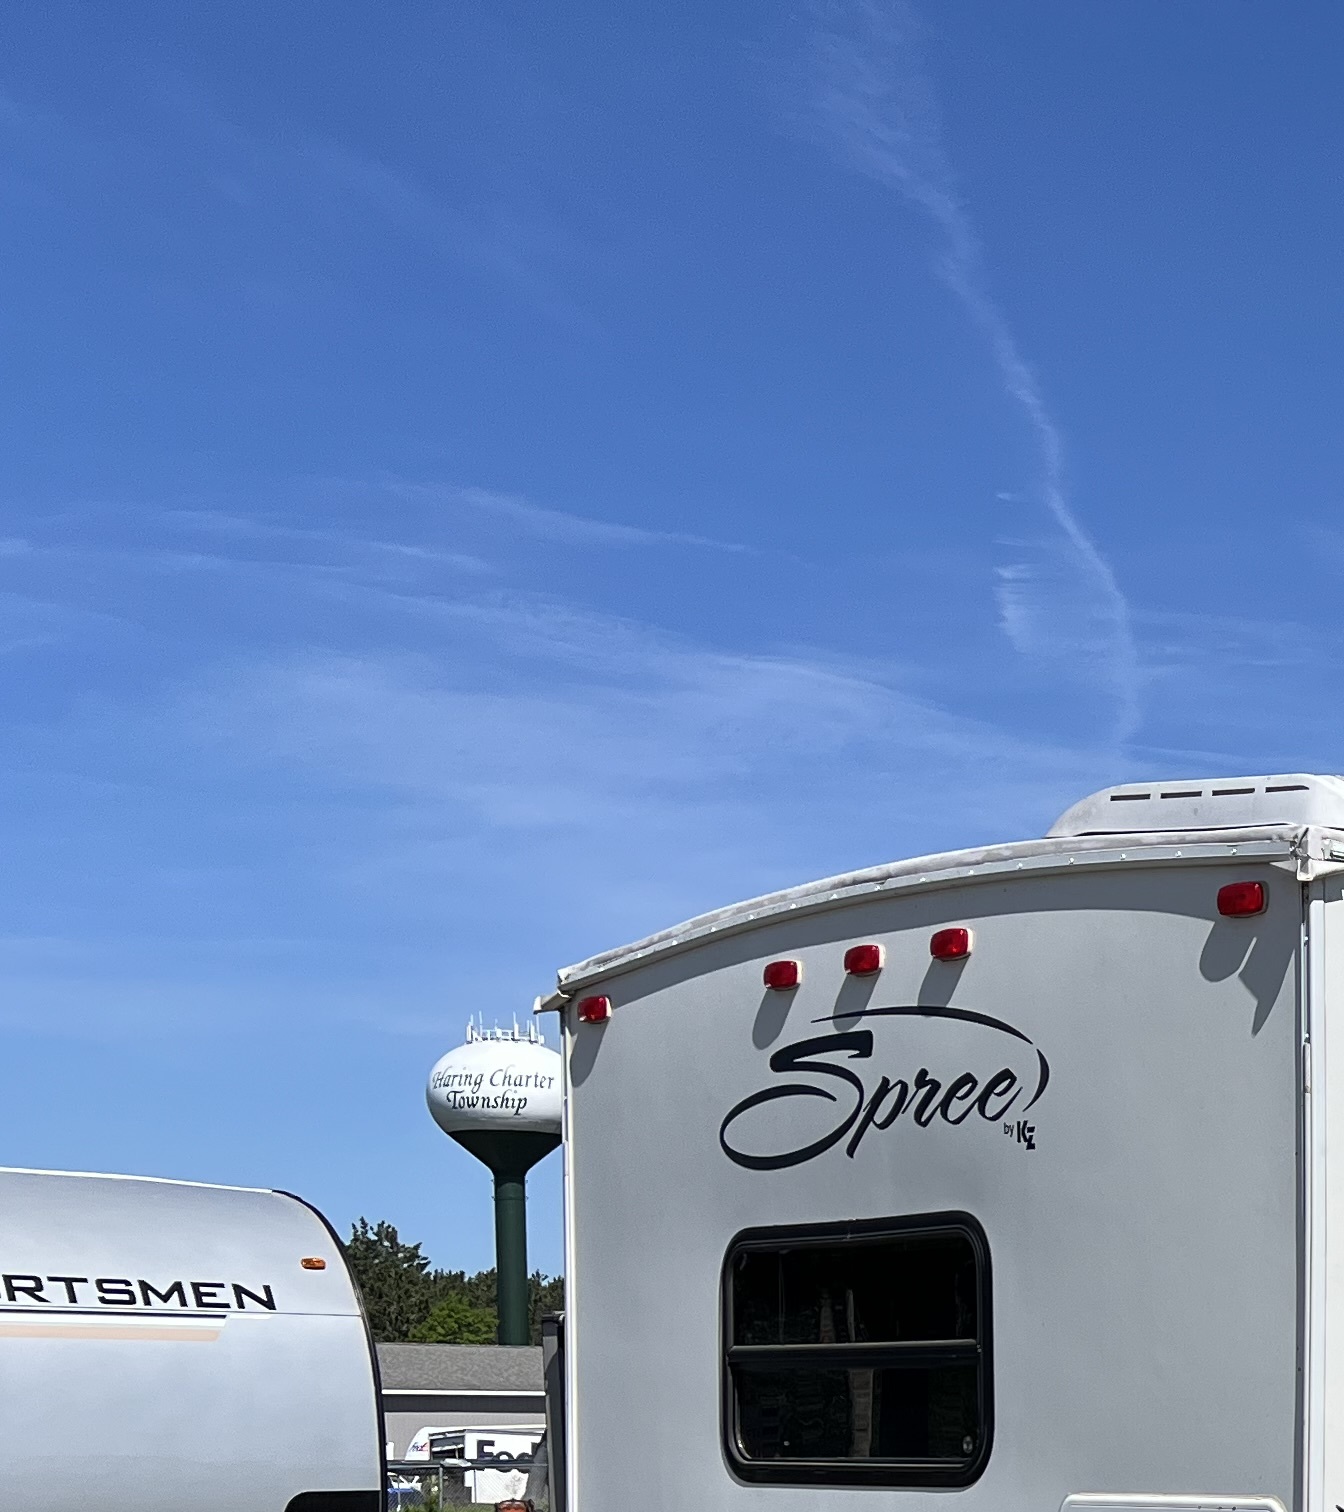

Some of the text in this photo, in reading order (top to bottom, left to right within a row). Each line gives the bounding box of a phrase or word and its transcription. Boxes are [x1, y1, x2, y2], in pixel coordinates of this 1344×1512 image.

[432, 1064, 555, 1094] Haring Charter
[446, 1089, 528, 1116] Township
[719, 1029, 1023, 1171] Spree
[1003, 1121, 1015, 1138] by
[0, 1273, 277, 1311] RTSMEN
